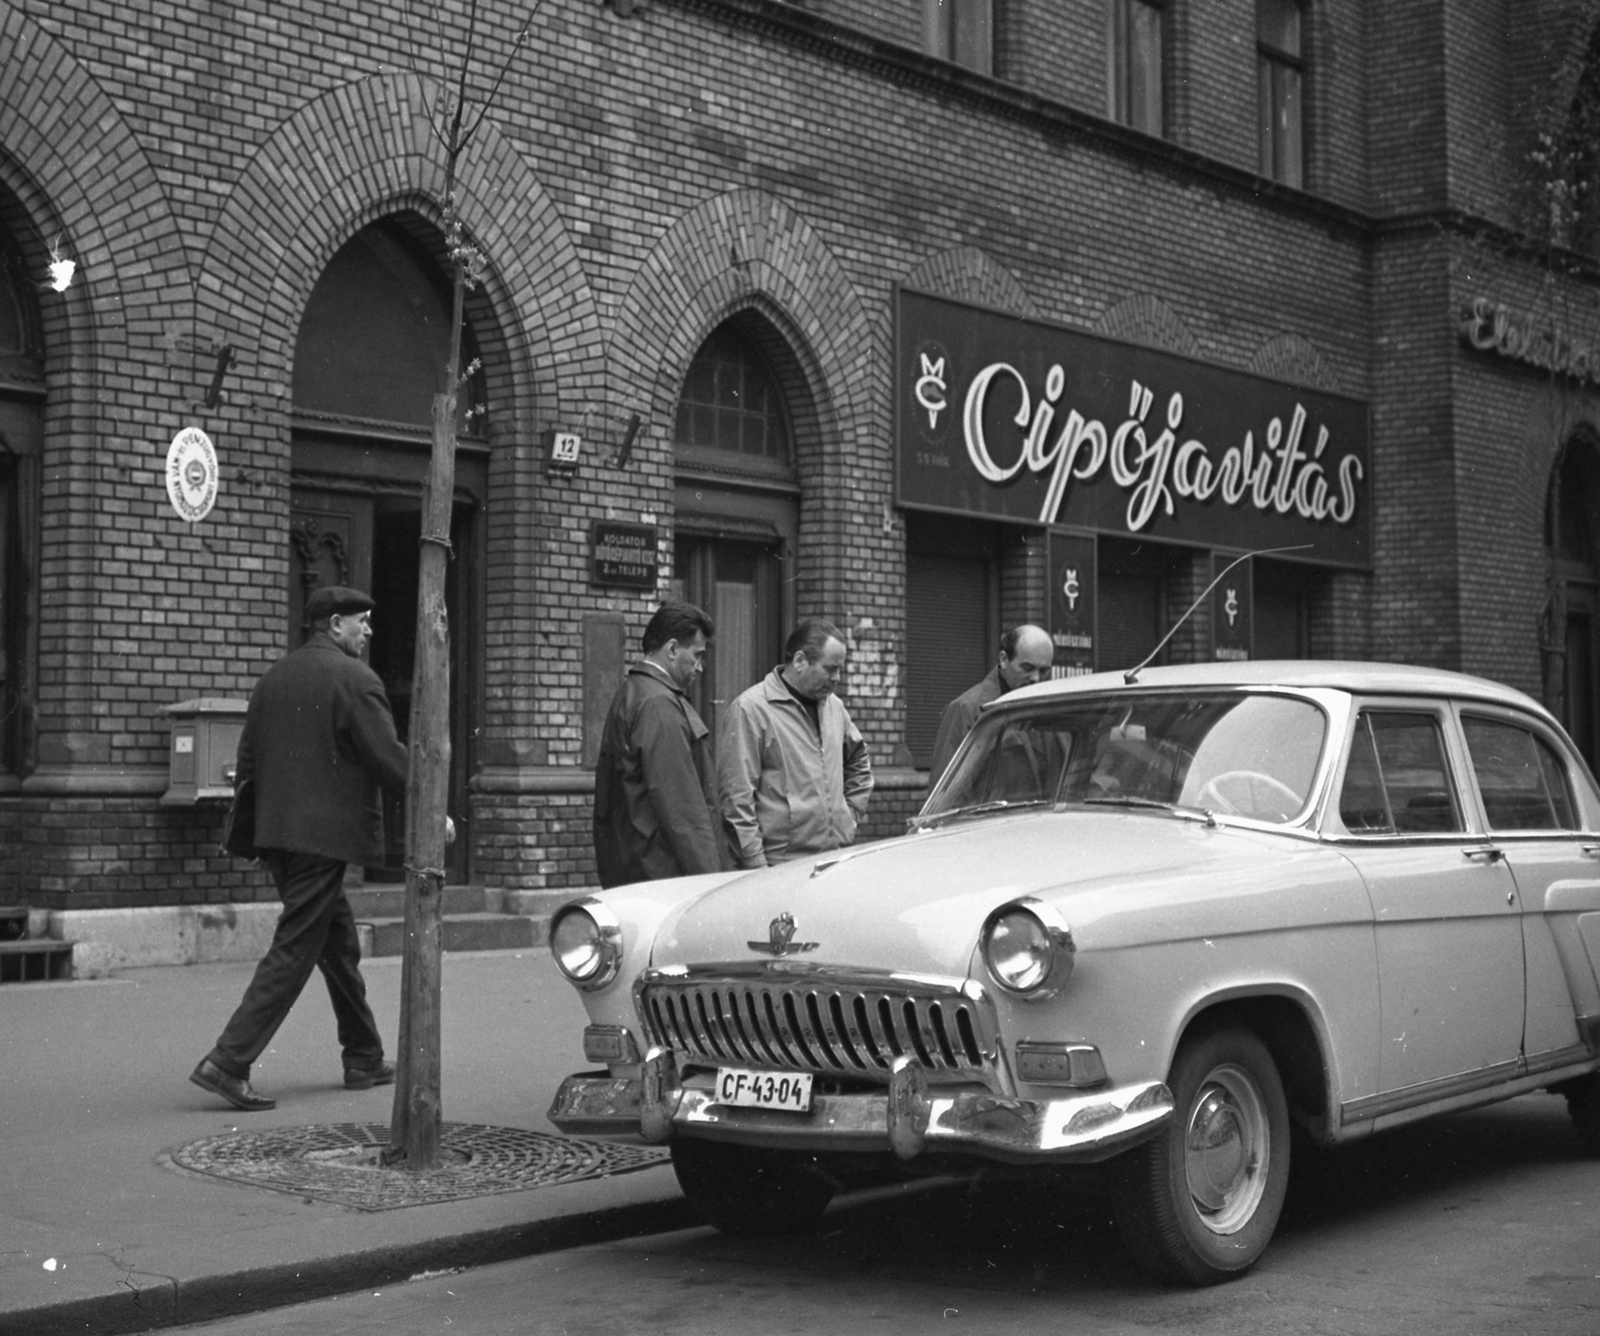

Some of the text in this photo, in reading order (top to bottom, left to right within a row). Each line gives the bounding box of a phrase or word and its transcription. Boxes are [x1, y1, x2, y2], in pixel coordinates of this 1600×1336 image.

[561, 437, 575, 453] 12
[604, 534, 646, 547] KOLDATOR
[618, 565, 648, 578] TELEPE
